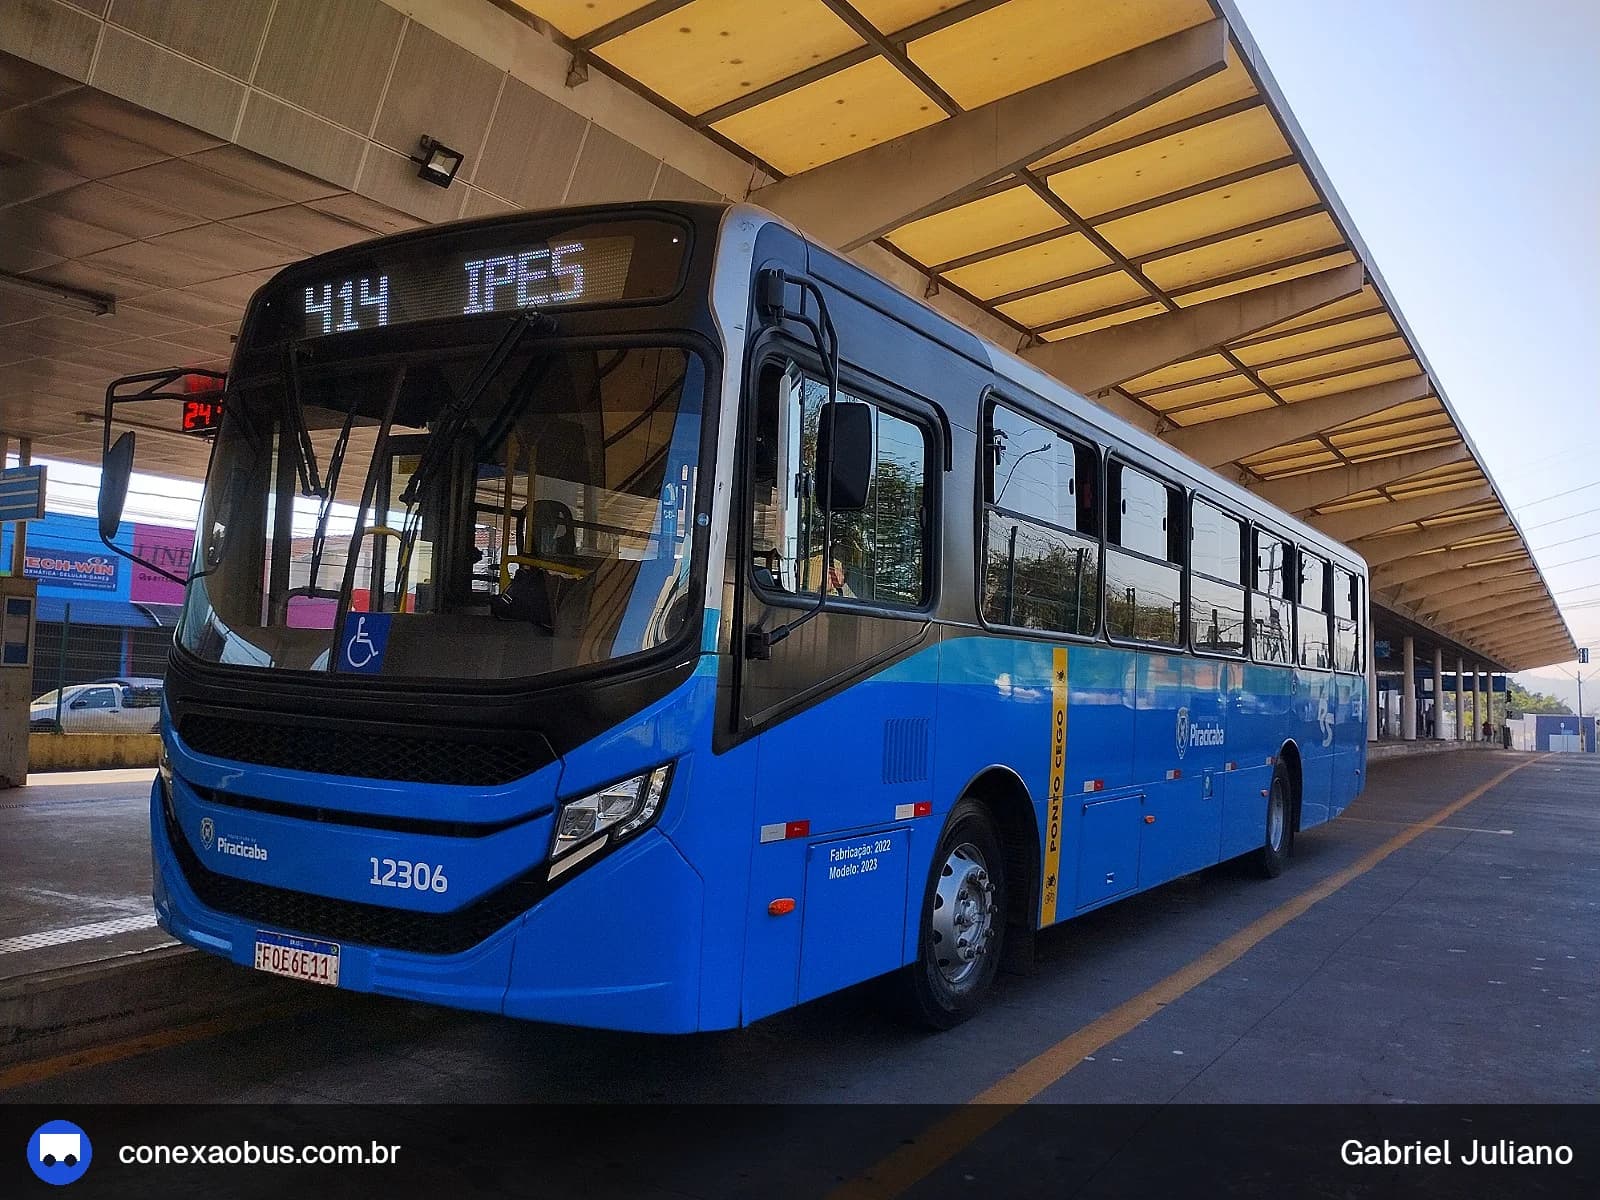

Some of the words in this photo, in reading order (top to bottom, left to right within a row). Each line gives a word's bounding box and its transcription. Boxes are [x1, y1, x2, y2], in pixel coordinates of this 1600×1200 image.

[305, 275, 388, 334] 414
[463, 242, 585, 315] IPES
[25, 557, 114, 576] ECH-WIN
[1189, 722, 1225, 747] Piracicaba
[1049, 776, 1061, 853] PONTO
[1055, 709, 1064, 769] CEGO
[217, 836, 268, 861] Piracicaba
[830, 843, 873, 862] Fabricação:
[874, 839, 891, 854] 2022
[369, 856, 448, 894] 12306
[828, 862, 860, 880] Modelo:
[860, 857, 878, 873] 2023
